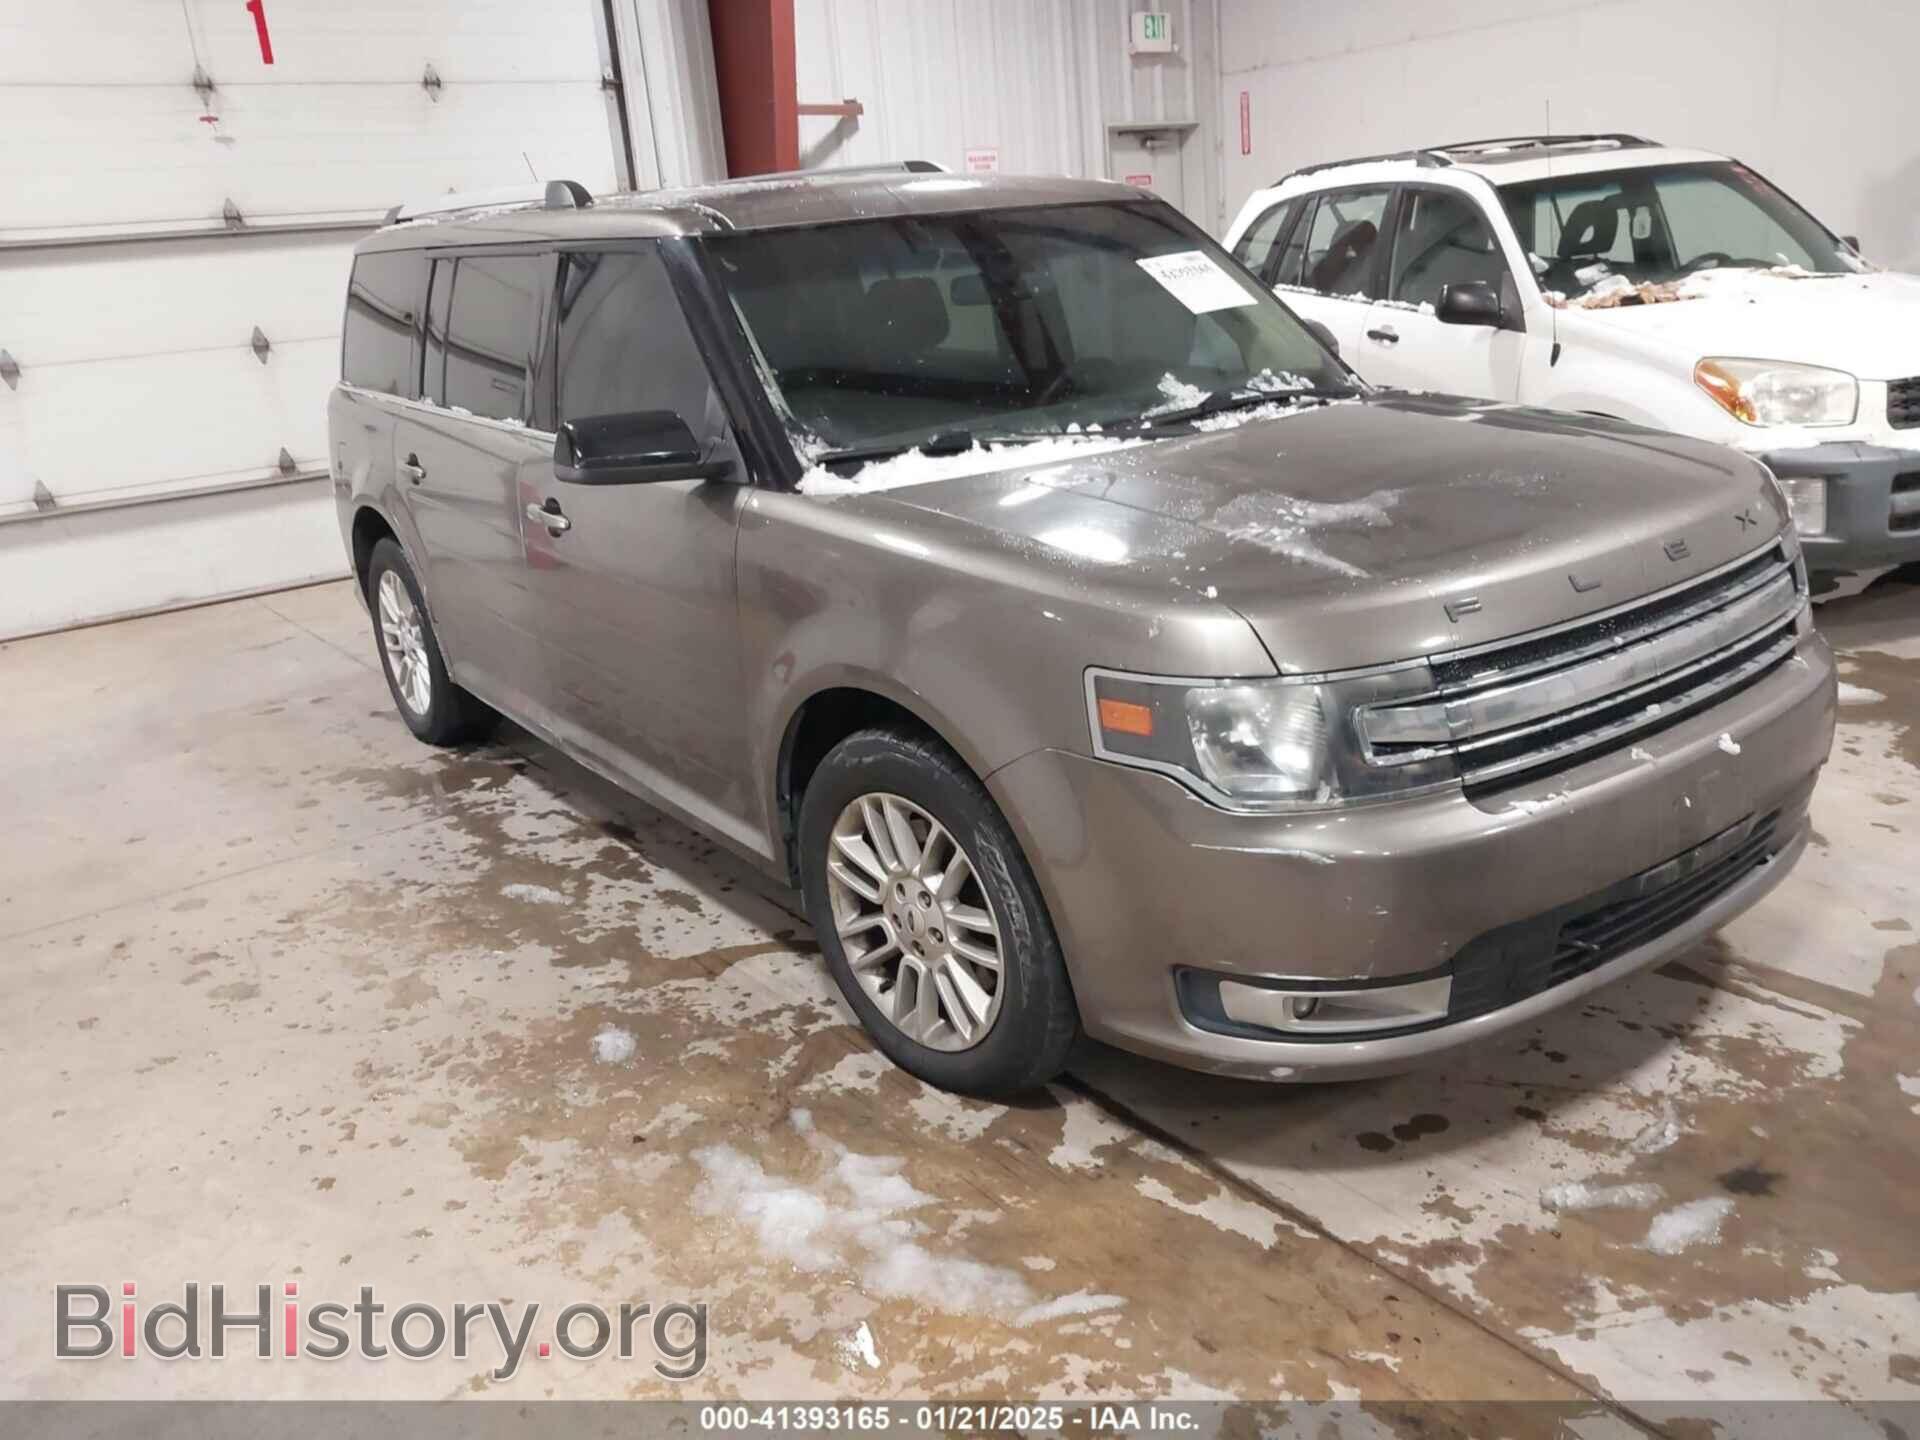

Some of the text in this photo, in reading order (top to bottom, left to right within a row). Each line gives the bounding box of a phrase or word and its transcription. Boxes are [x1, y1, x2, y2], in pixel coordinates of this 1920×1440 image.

[246, 0, 274, 65] 1
[1144, 15, 1166, 40] EXIT
[1444, 509, 1757, 623] FLEX
